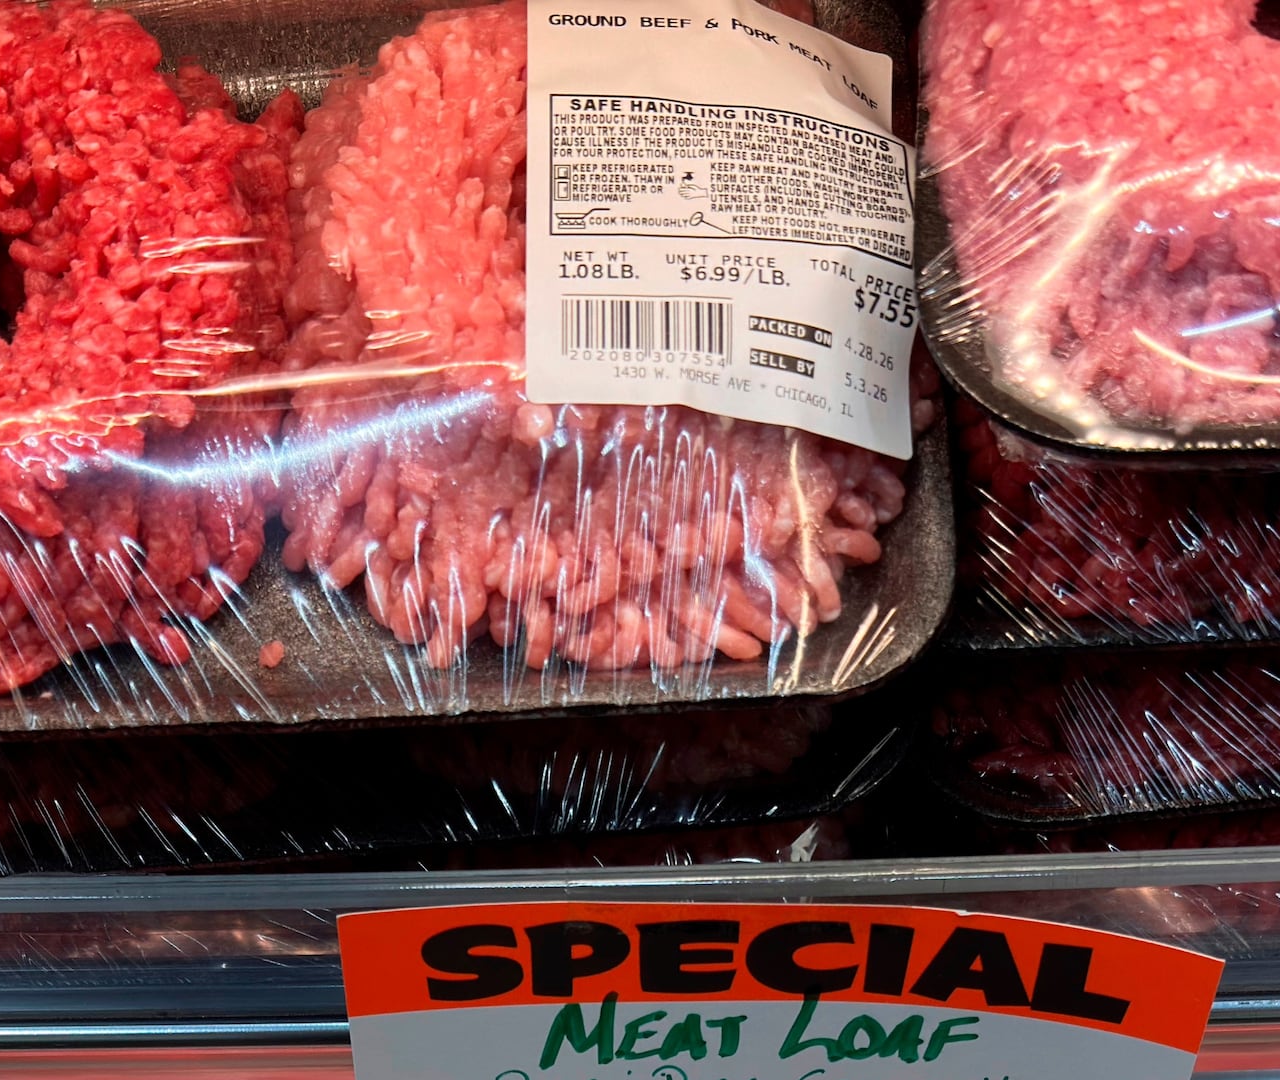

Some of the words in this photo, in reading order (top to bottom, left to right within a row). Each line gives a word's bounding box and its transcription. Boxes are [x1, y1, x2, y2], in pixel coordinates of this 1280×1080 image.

[548, 14, 627, 27] GROUND
[640, 16, 692, 28] BEEF
[705, 18, 719, 29] &
[731, 18, 780, 45] PORK
[789, 42, 833, 71] MEAT
[842, 75, 878, 110] LOAF
[570, 99, 622, 112] SAFE
[631, 100, 736, 119] HANDLING
[744, 110, 890, 152] INSTRUCTIONS
[572, 165, 598, 173] KEEP
[601, 165, 674, 173] REFRIGERATED
[589, 216, 617, 226] COOK
[621, 216, 689, 228] THOROUGHLY
[558, 264, 640, 279] 1.08LB.
[680, 266, 790, 287] $6.99/LB.
[854, 286, 917, 328] $7.55
[563, 251, 595, 262] NET
[607, 251, 629, 262] WT
[665, 254, 709, 265] UNIT
[722, 255, 776, 268] PRICE
[810, 259, 856, 282] TOTAL
[865, 275, 914, 302] PRICE
[749, 317, 806, 338] PACKED
[814, 330, 832, 347] ON
[844, 337, 894, 371] 4.28.26
[613, 366, 647, 379] 1430
[654, 368, 670, 379] W.
[680, 368, 720, 386] MORSE
[727, 377, 751, 392] AVE
[775, 386, 832, 412] CHICAGO,
[841, 402, 854, 418] IL
[750, 350, 787, 369] SELL
[797, 362, 815, 377] BY
[844, 372, 888, 403] 5.3.26
[421, 920, 1130, 1024] SPECIAL
[539, 991, 748, 1070] MEAT
[778, 985, 980, 1064] LOAF
